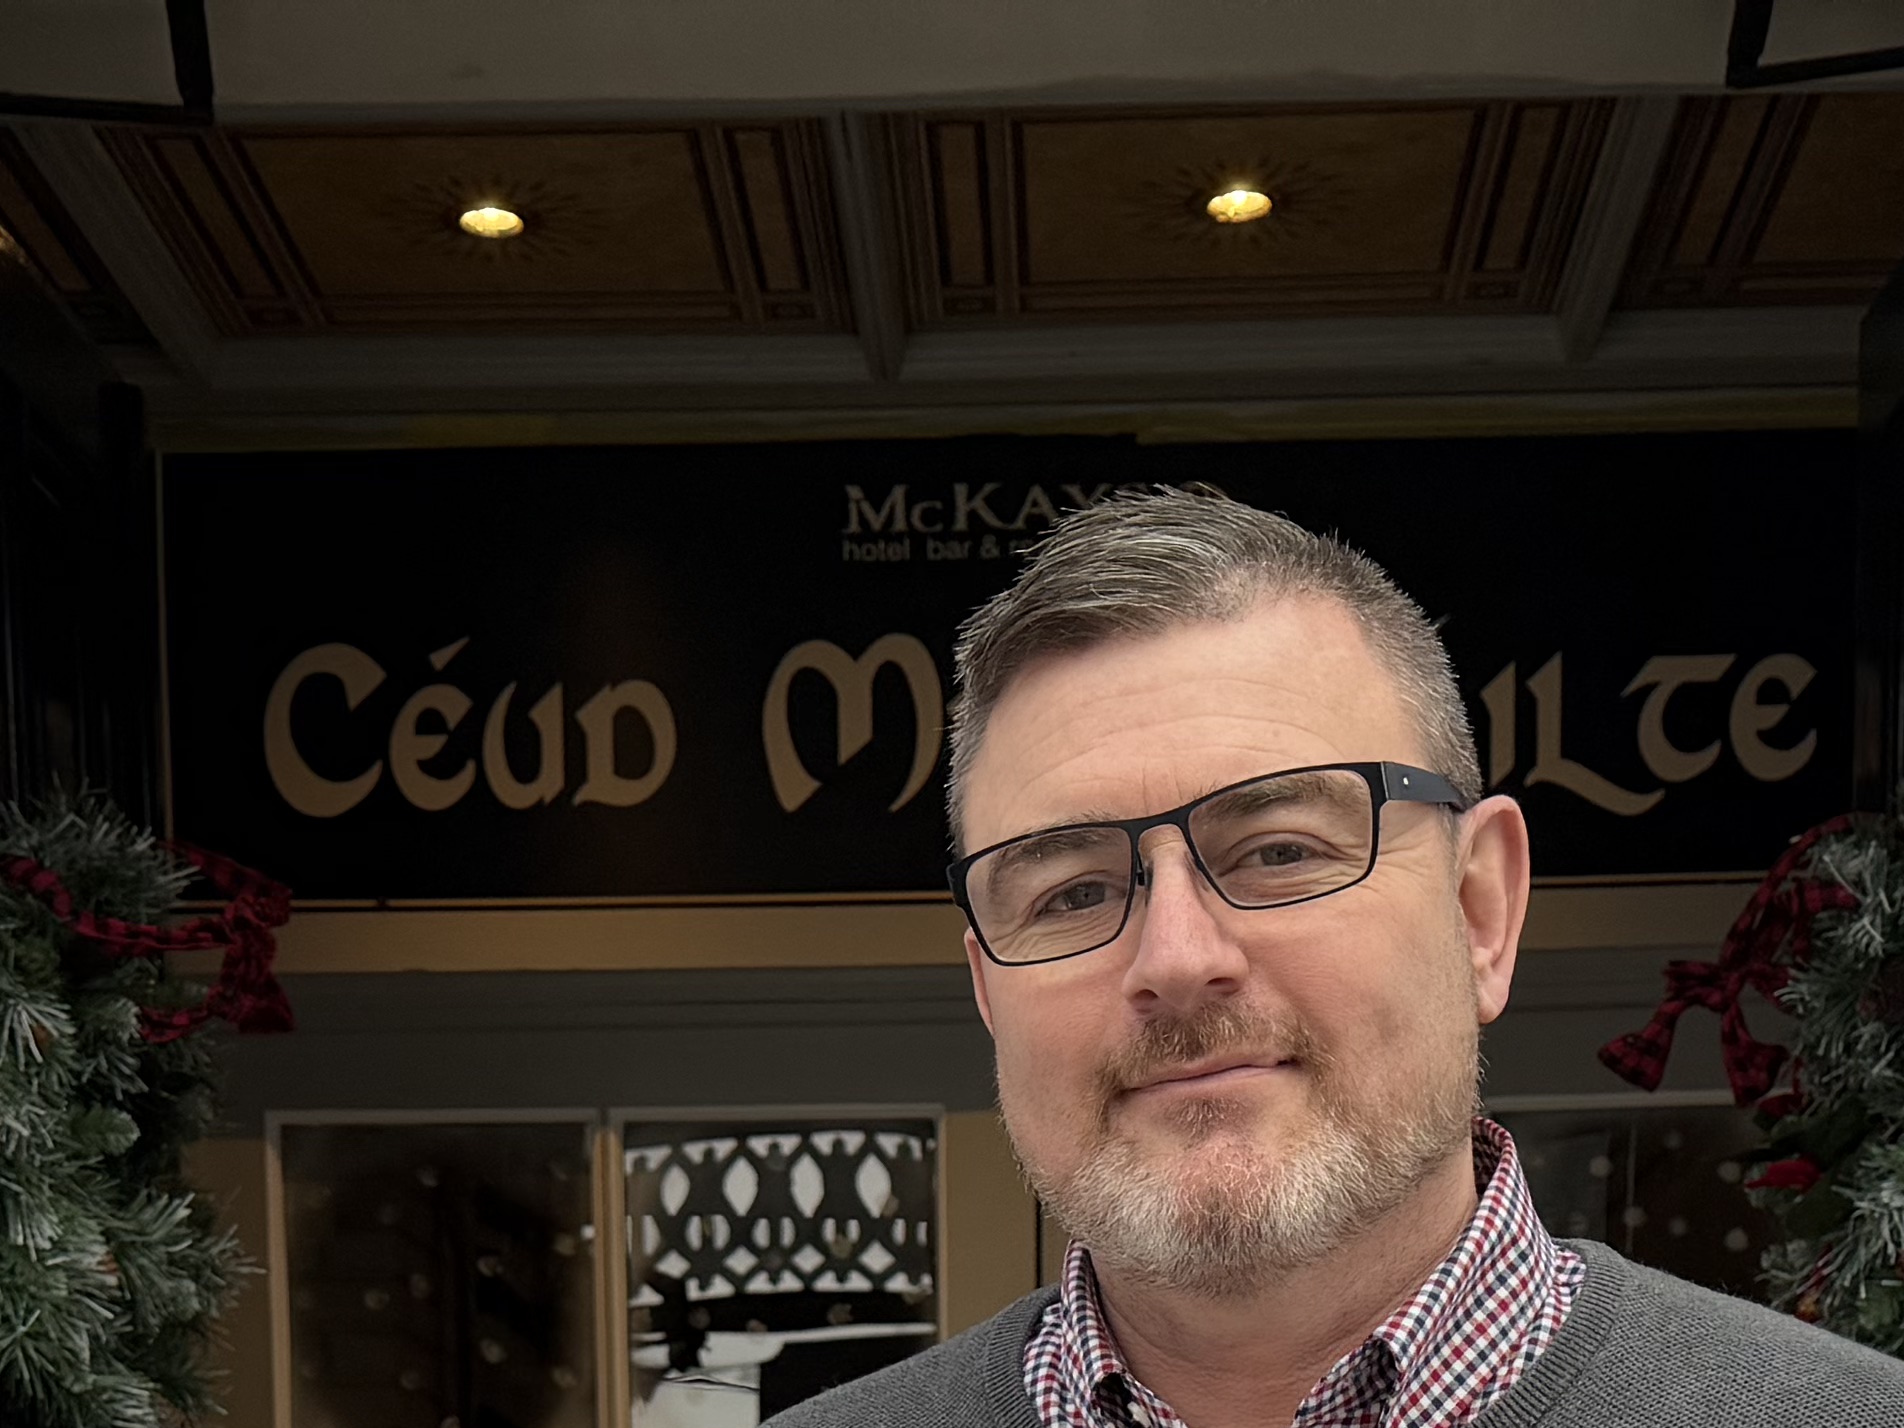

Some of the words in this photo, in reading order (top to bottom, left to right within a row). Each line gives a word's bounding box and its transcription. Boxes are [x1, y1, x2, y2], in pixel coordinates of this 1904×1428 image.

[842, 482, 1113, 535] McKAY
[841, 535, 911, 562] hotel
[925, 535, 970, 562] bar
